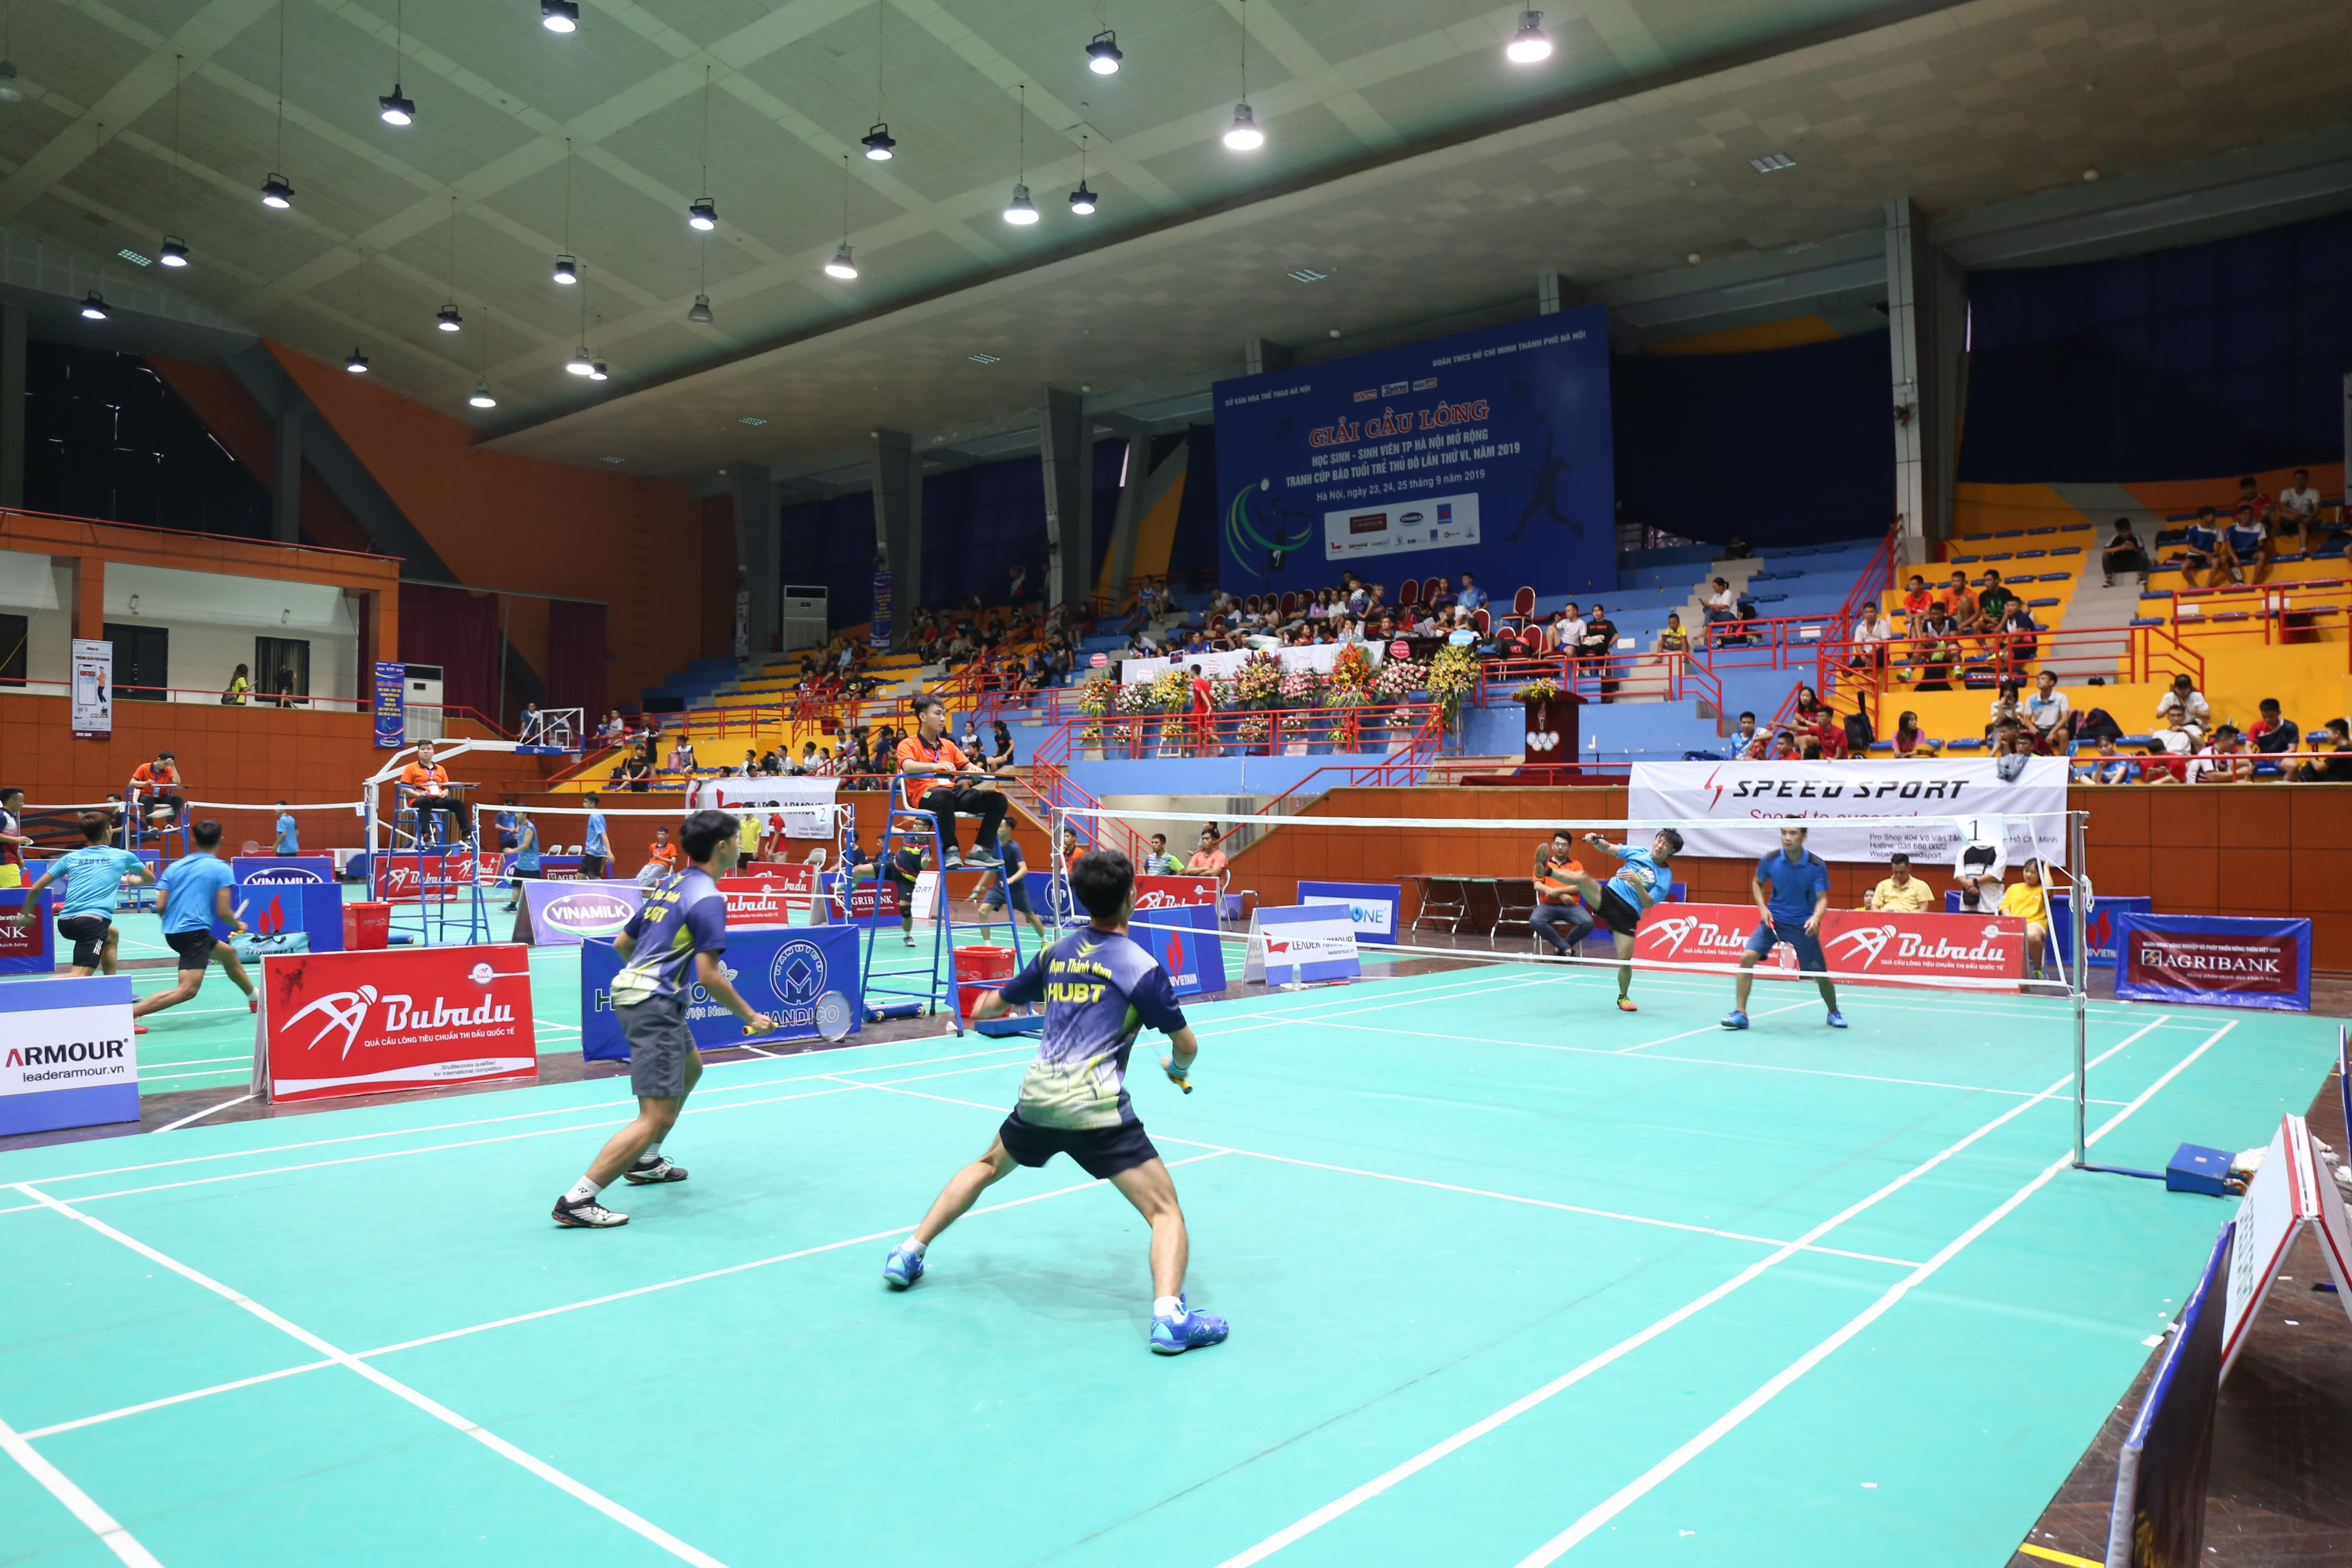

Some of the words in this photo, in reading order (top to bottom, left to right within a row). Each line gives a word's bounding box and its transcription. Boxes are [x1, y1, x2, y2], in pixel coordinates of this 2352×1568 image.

[1453, 353, 1471, 362] TNCS
[1473, 349, 1482, 359] HỒ
[1498, 345, 1516, 354] MINH
[1518, 340, 1542, 350] THÀNH
[1544, 335, 1559, 345] PHỐ
[1561, 333, 1570, 342] HÀ
[1573, 330, 1586, 340] NỘI
[1274, 389, 1289, 398] THAO
[1300, 384, 1311, 393] NỘI
[1310, 416, 1360, 447] GIẢI
[1366, 407, 1413, 438] CẦU
[1419, 400, 1489, 429] LÔNG
[1312, 455, 1328, 468] HỌC
[1331, 451, 1350, 464] SINH
[1358, 447, 1378, 459] SINH
[1380, 442, 1400, 456] VIÊN
[1402, 441, 1412, 452] TP
[1415, 437, 1427, 450] HÀ
[1429, 434, 1444, 450] NỘI
[1447, 429, 1461, 445] MỞ
[1464, 429, 1488, 444] RỘNG
[1286, 474, 1312, 487] TRANH
[1314, 469, 1330, 483] CÚP
[1333, 467, 1349, 481] BÁO
[1351, 461, 1369, 478] TUỔI
[1372, 458, 1387, 475] TRẺ
[1390, 455, 1405, 472] THỦ
[1408, 458, 1419, 469] ĐÔ
[1422, 452, 1439, 467] LẦN
[1441, 448, 1459, 464] THỨ
[1461, 450, 1471, 462] VI,
[1474, 445, 1495, 459] NĂM
[1498, 442, 1520, 456] 2019
[1317, 492, 1328, 501] Hà
[1330, 490, 1345, 501] Nội,
[1348, 486, 1367, 499] ngày
[1369, 484, 1381, 494] 23,
[1384, 482, 1395, 492] 24,
[1398, 480, 1407, 490] 25
[1410, 477, 1433, 488] tháng
[1436, 475, 1441, 485] 9
[1444, 474, 1462, 484] năm
[1464, 469, 1485, 481] 2019
[1733, 780, 1846, 798] SPEED
[1853, 780, 1970, 799] SPORT
[358, 804, 361, 814] 3
[820, 808, 826, 822] 2
[1884, 834, 1902, 842] Shop
[1968, 819, 1982, 841] 1
[724, 895, 778, 911] ubadu
[851, 895, 893, 905] GRIBNK
[551, 905, 627, 920] VINAMILK
[1898, 932, 2006, 962] Bubadu
[1092, 962, 1113, 980] Nam
[2162, 954, 2281, 973] AGRIBANK
[1169, 973, 1198, 987] ROVIETNAM
[1048, 982, 1106, 1004] HUBT
[381, 993, 515, 1031] Bubadu
[685, 1008, 706, 1020] Việt
[708, 1006, 733, 1017] Nam
[381, 1036, 396, 1046] CẦU
[398, 1035, 417, 1044] LÔNG
[419, 1034, 434, 1043] TIÊU
[435, 1031, 458, 1041] CHUẨN
[472, 1029, 485, 1038] ĐẤU
[487, 1027, 505, 1037] QUỐC
[506, 1026, 515, 1035] TẾ
[6, 1040, 124, 1068] ARMOUR
[23, 1064, 125, 1083] leaderarmour.vn
[441, 1063, 474, 1071] Shuttlecocks
[475, 1060, 496, 1068] qualified
[475, 1065, 504, 1074] competition
